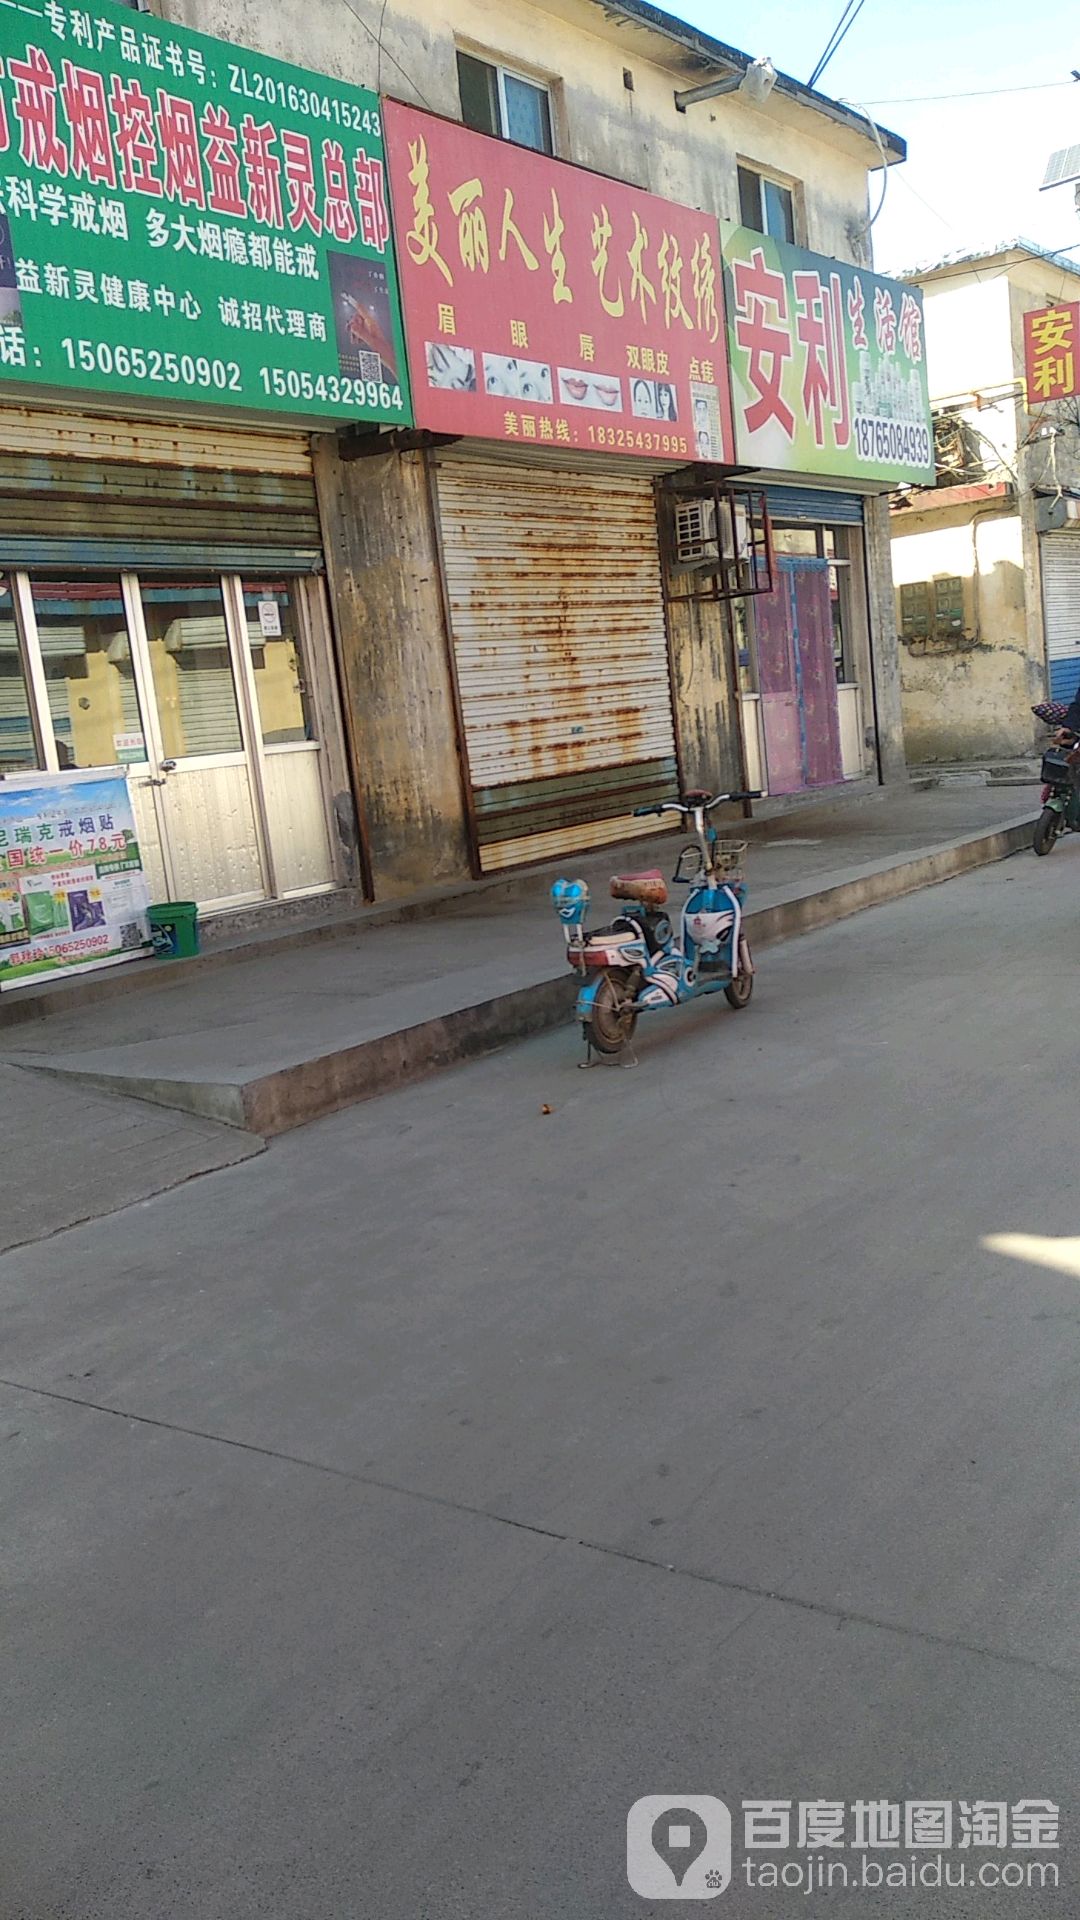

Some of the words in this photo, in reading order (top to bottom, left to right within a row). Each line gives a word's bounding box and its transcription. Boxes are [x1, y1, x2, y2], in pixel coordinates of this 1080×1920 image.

[0, 44, 391, 253] 戒烟控烟益新灵总部
[146, 209, 320, 280] 多大烟瘾都能戒
[15, 257, 202, 322] 益新灵健康中心
[218, 296, 327, 342] 诚招代理商
[437, 303, 456, 336] 眉
[510, 319, 529, 349] 眼
[579, 333, 595, 362] 唇
[627, 346, 670, 376] 双眼皮
[688, 356, 715, 384] 点痣
[732, 246, 851, 450] 安利
[848, 275, 922, 364] 生活馆
[1031, 309, 1074, 398] 安利
[259, 366, 403, 411] 15054329964
[854, 417, 930, 464] 18765084939
